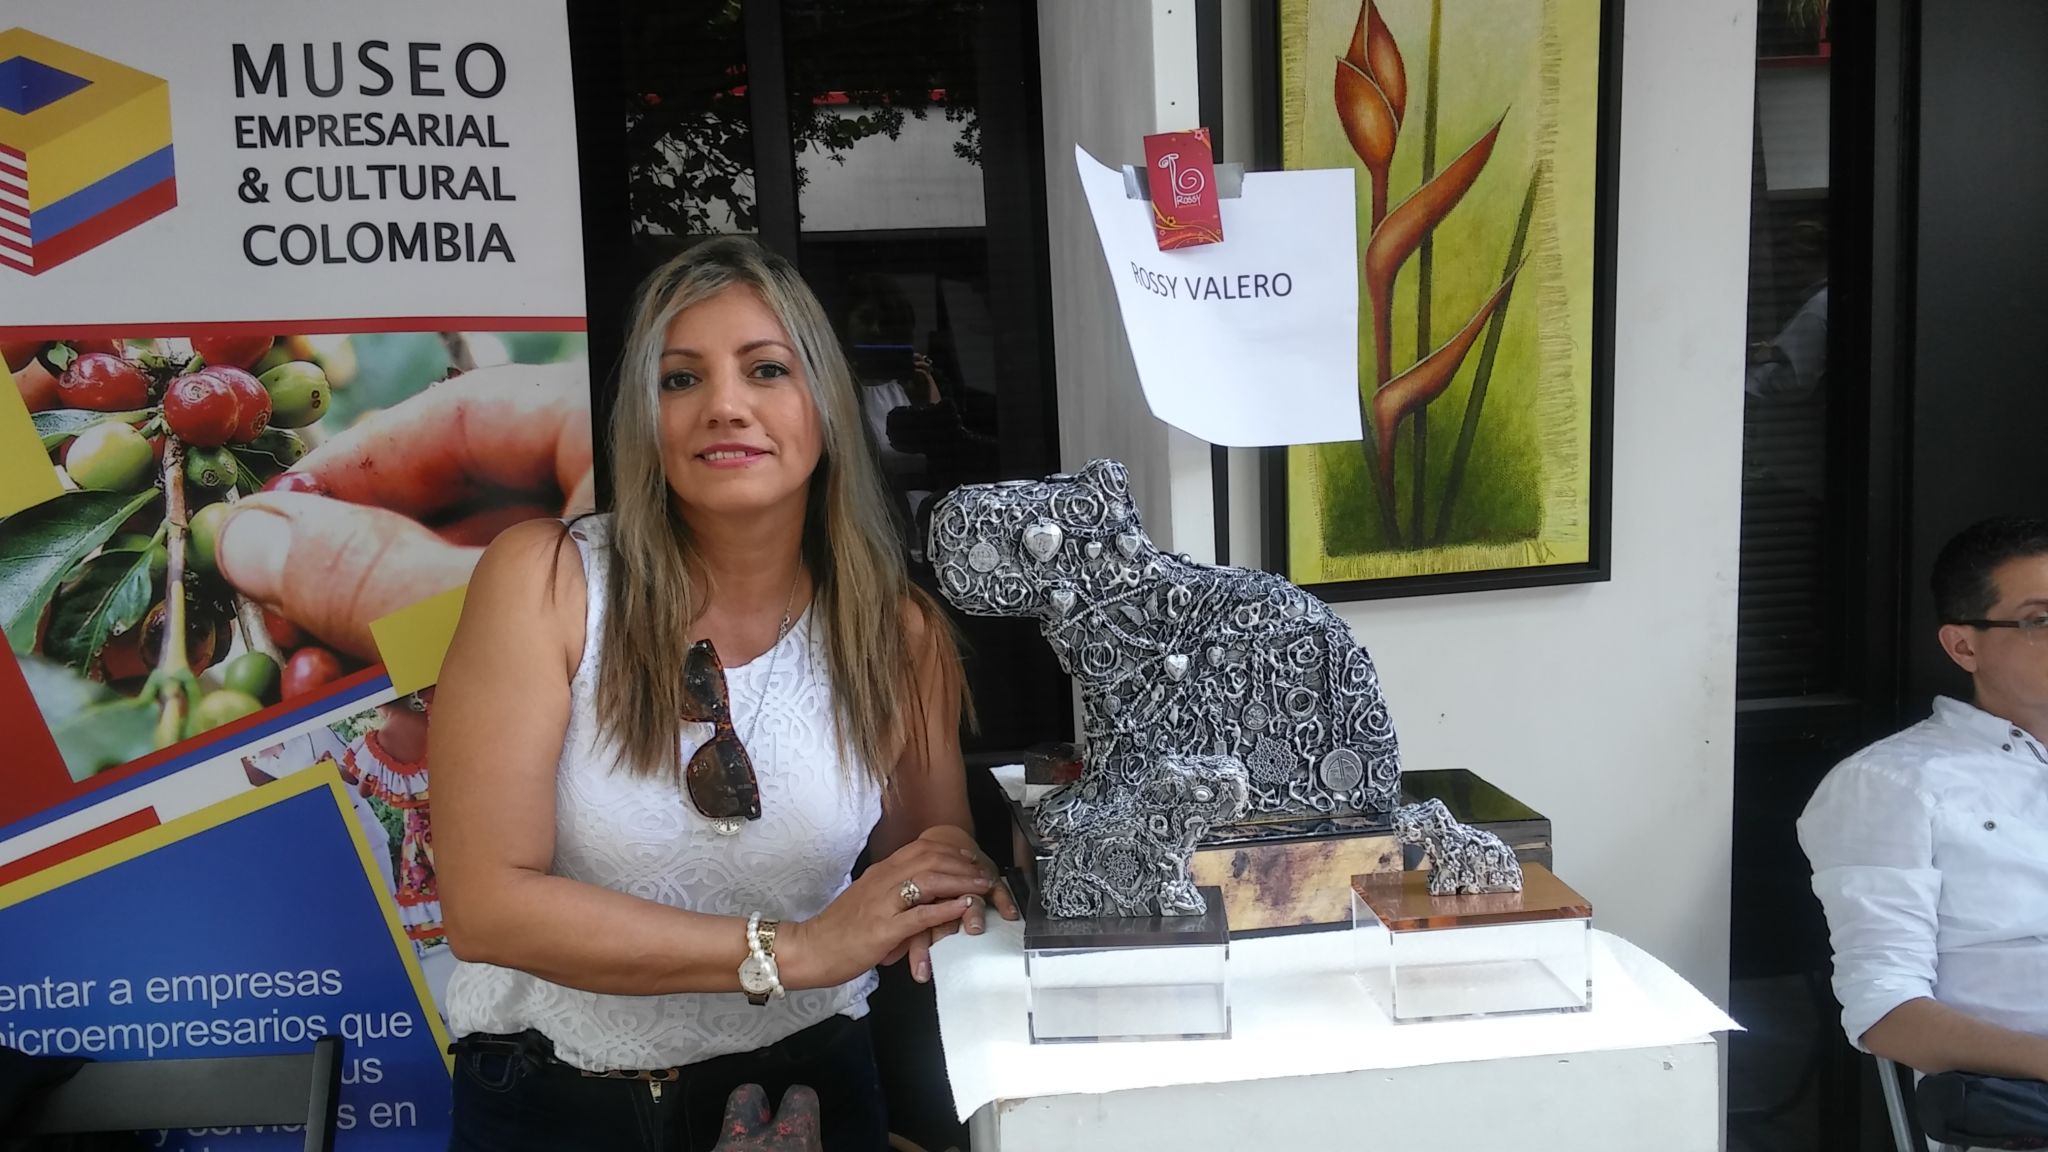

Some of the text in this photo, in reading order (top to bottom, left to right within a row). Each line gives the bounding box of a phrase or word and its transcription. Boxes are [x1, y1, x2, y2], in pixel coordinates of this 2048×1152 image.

[231, 40, 507, 99] MUSEO
[234, 111, 510, 149] EMPRESARIAL
[237, 164, 517, 204] & CULTURAL
[242, 222, 516, 267] COLOMBIA
[1131, 261, 1293, 301] ROSSY VALERO
[0, 968, 343, 1012] entar a empresas
[339, 1010, 413, 1048] que
[340, 1057, 384, 1085] us
[368, 1100, 418, 1129] en
